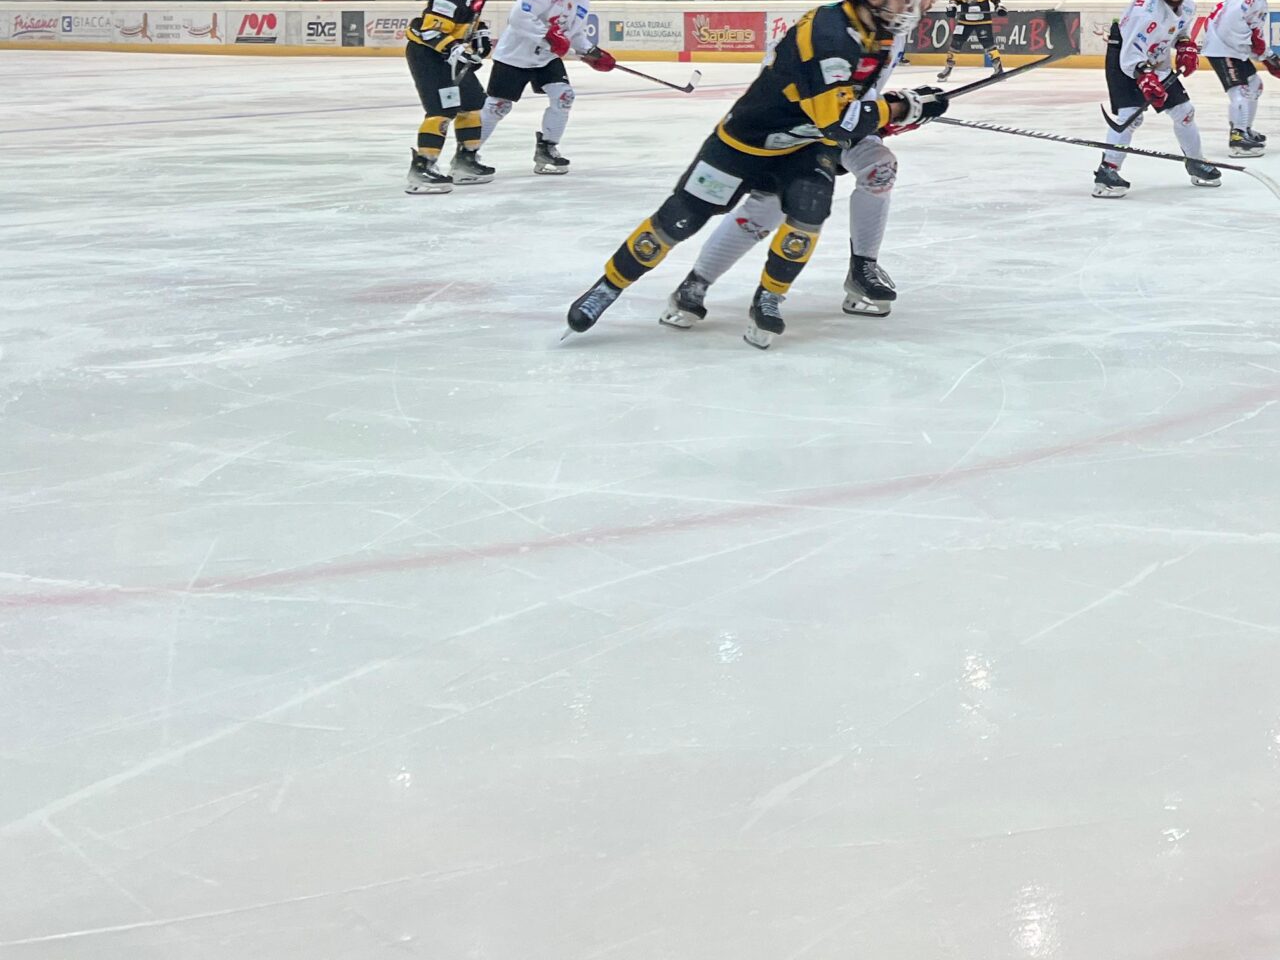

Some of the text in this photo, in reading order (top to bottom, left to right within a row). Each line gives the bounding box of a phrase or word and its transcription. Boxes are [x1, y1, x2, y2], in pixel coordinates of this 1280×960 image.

[73, 16, 111, 27] GIACCA
[625, 21, 672, 29] CASSA RURALE
[625, 30, 682, 38] ALTA VALSUGANA
[699, 25, 755, 45] Sapiens
